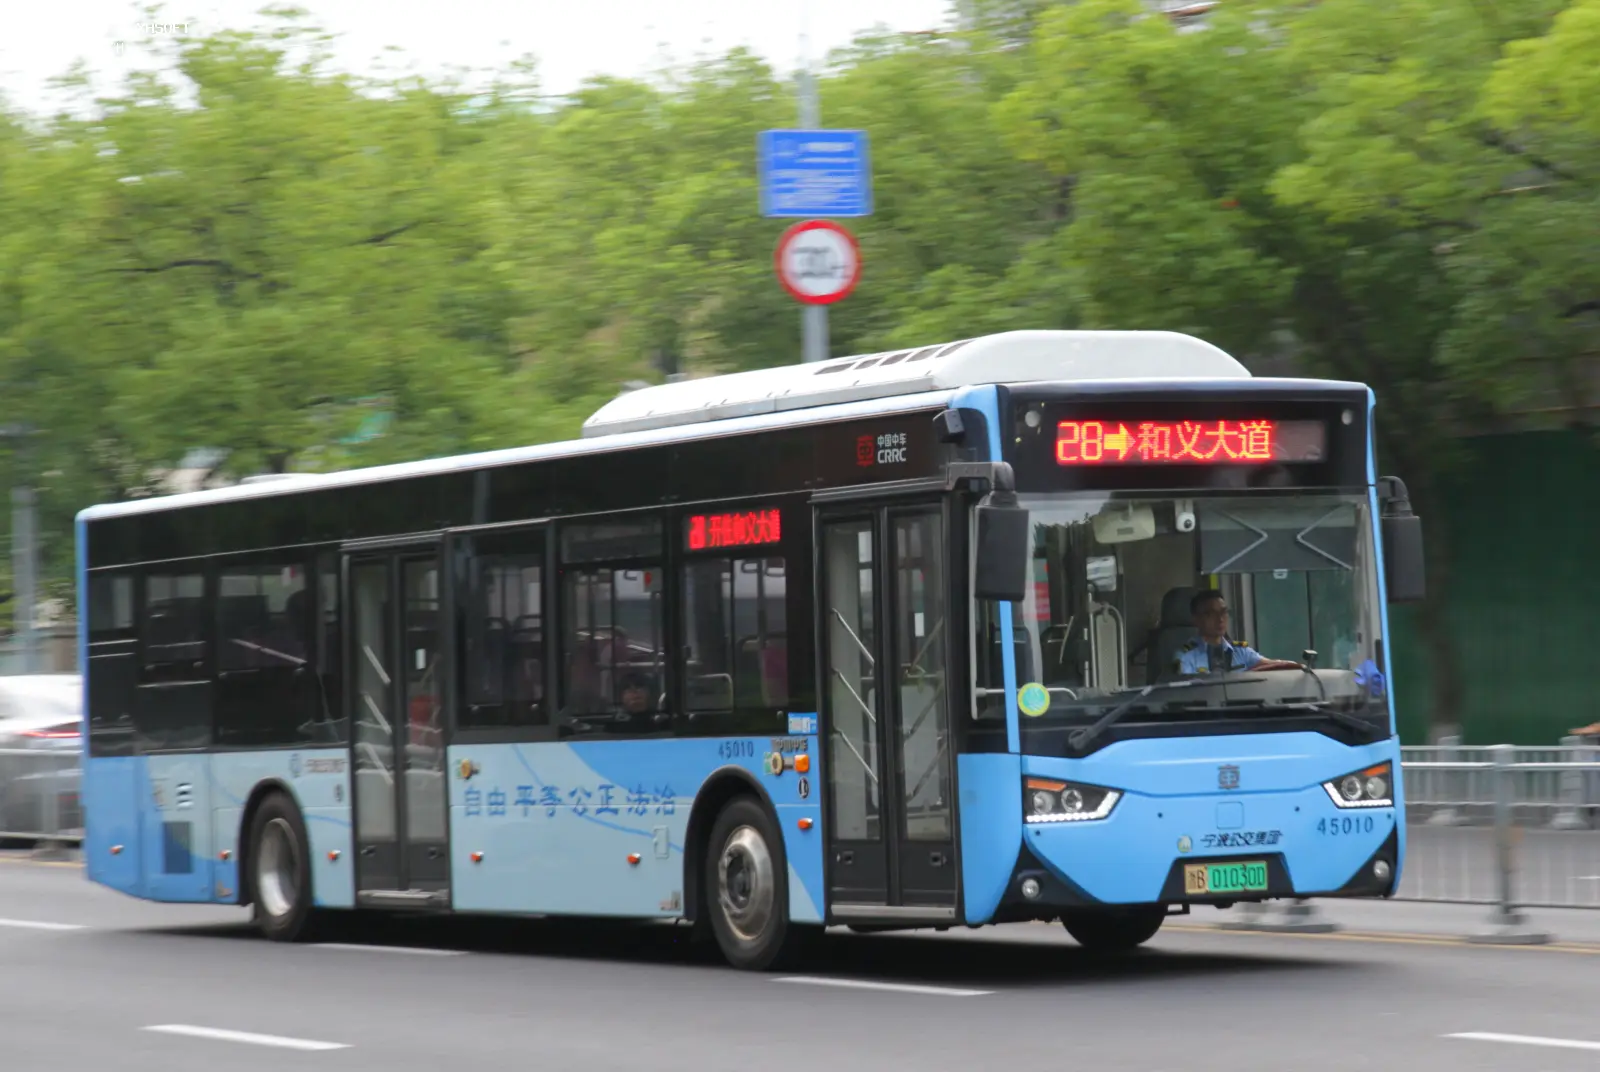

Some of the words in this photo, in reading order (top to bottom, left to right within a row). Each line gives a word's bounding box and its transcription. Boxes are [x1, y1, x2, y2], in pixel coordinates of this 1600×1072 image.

[877, 432, 907, 448] 中国中车
[1058, 421, 1102, 460] 28
[1137, 420, 1271, 460] 和义大道
[877, 447, 907, 464] CRRC
[719, 740, 754, 759] 45010
[1317, 816, 1374, 836] 45010
